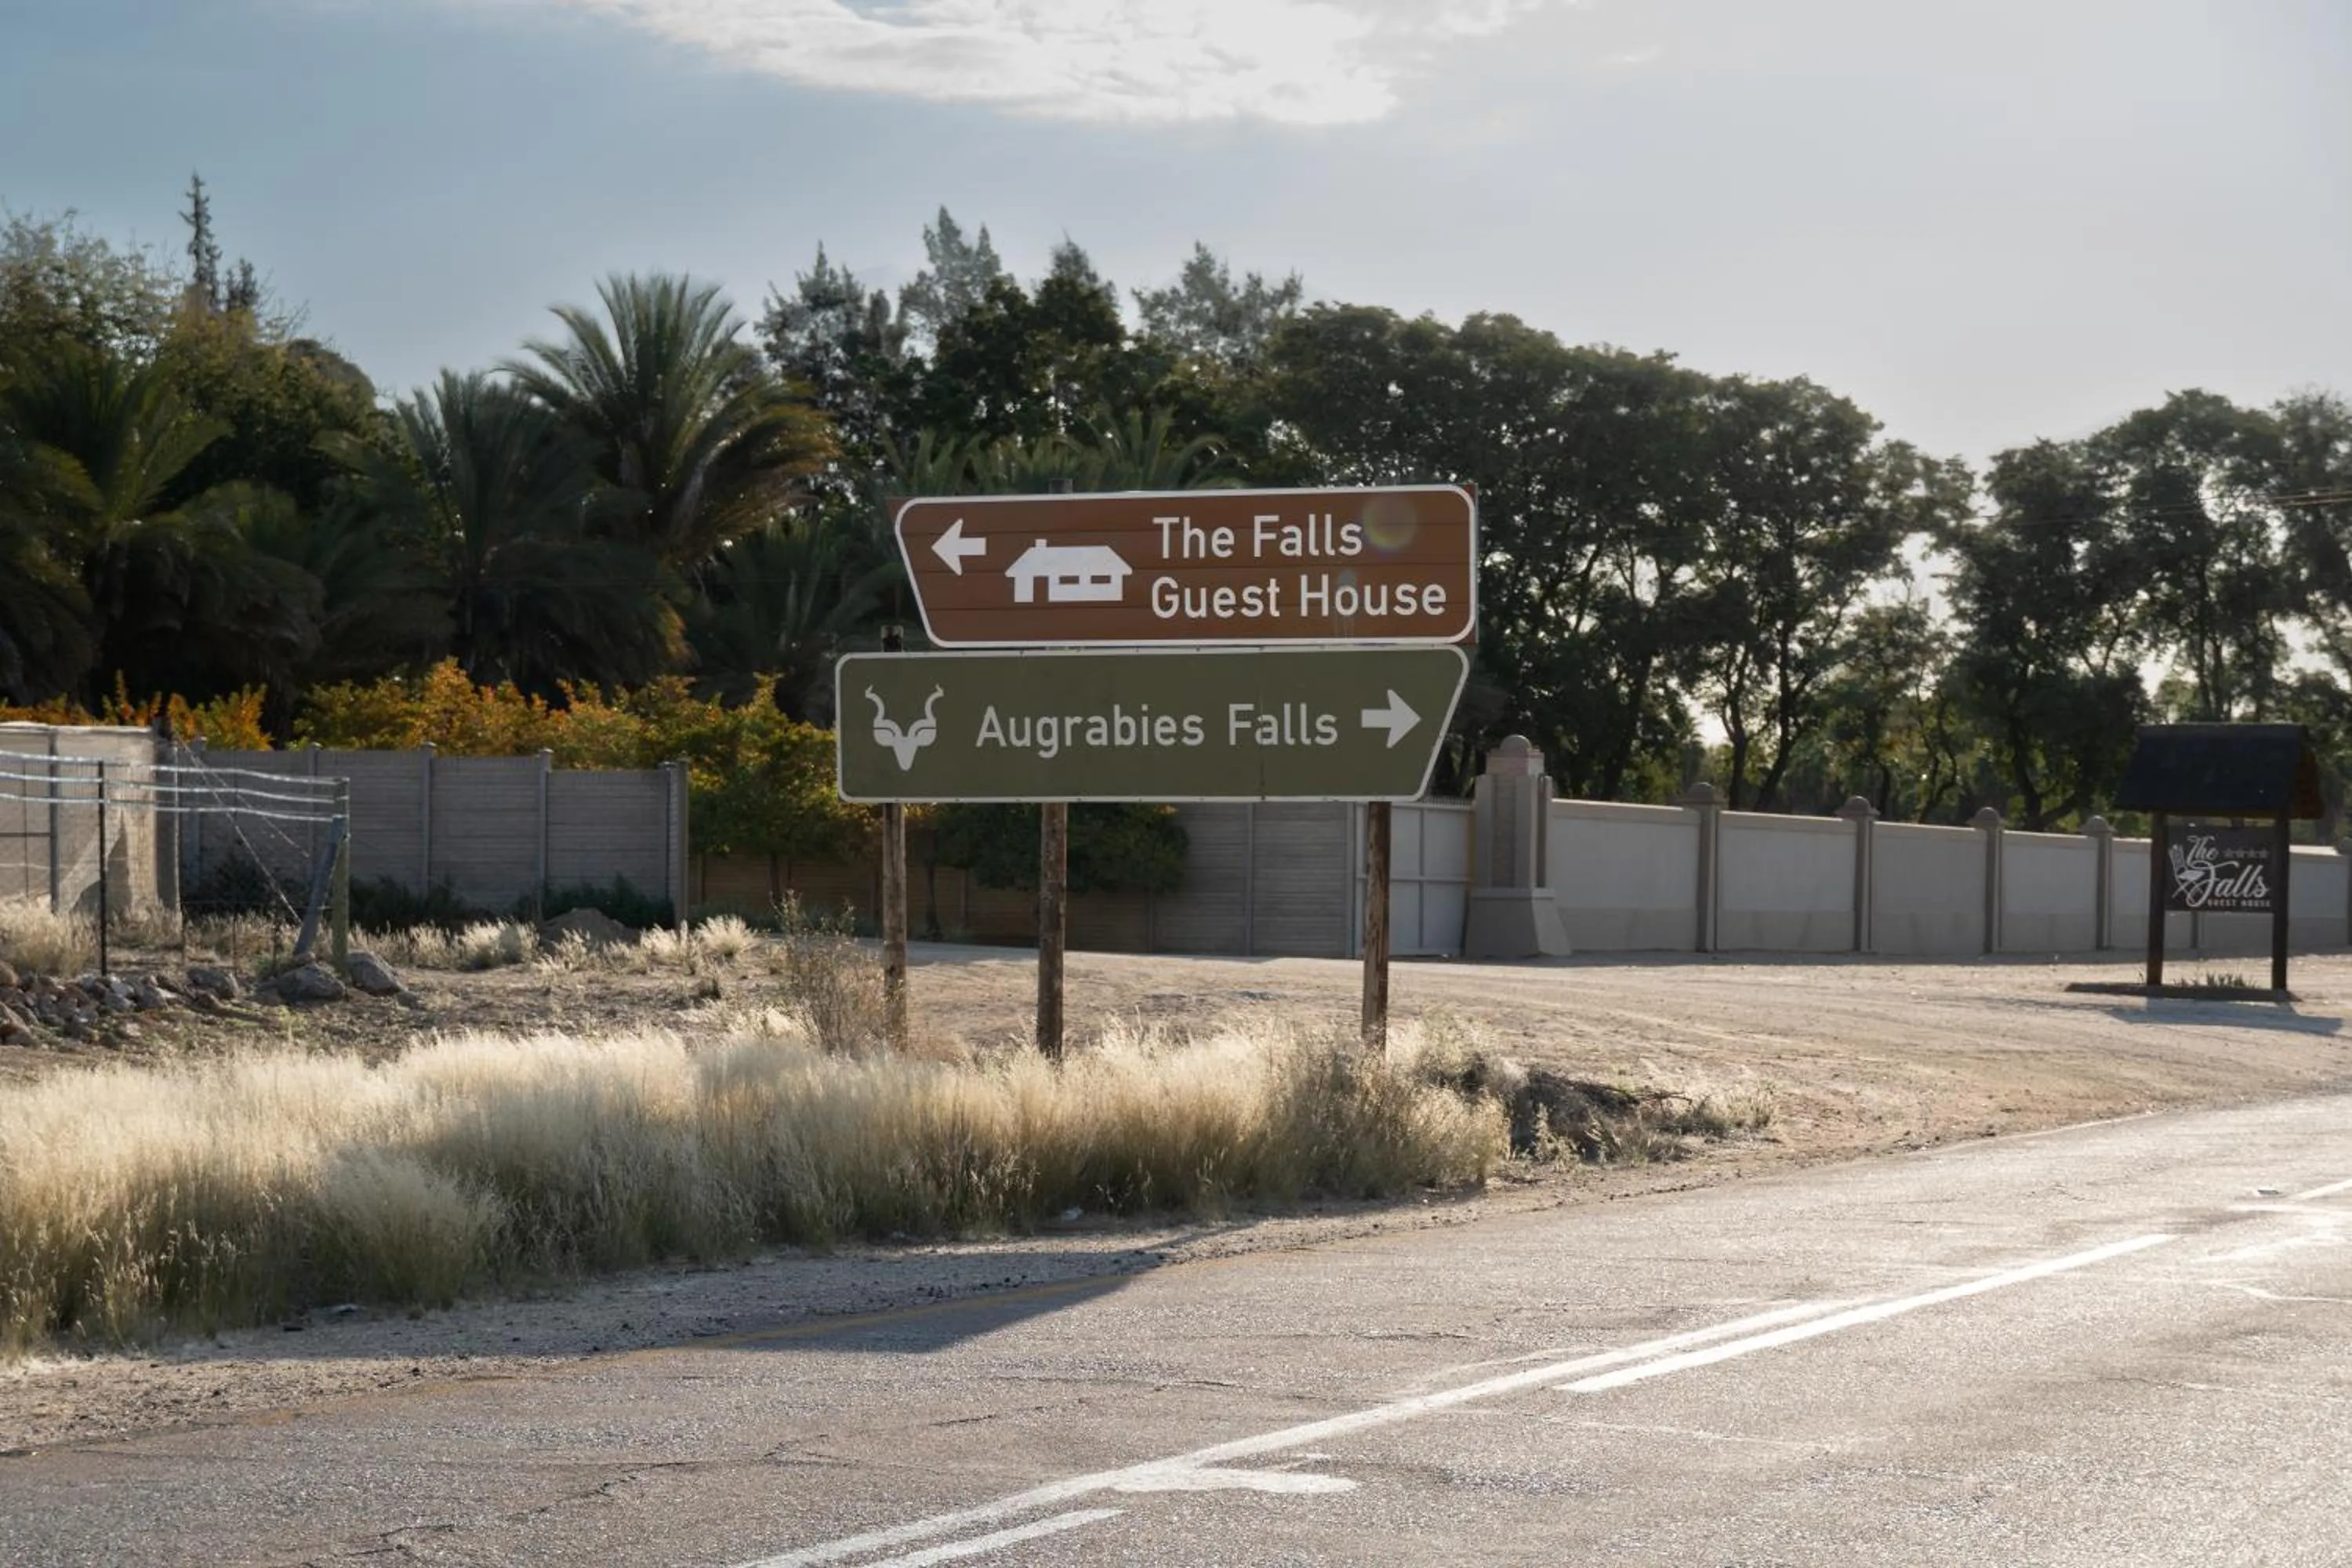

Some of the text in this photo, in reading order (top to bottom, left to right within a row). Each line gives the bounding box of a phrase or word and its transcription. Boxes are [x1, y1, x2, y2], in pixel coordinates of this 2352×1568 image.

[1152, 514, 1363, 560] The Falls
[1151, 574, 1447, 619] Guest House
[975, 702, 1339, 759] Augrabies Falls
[2187, 835, 2219, 866] The
[2186, 860, 2270, 907] Falls
